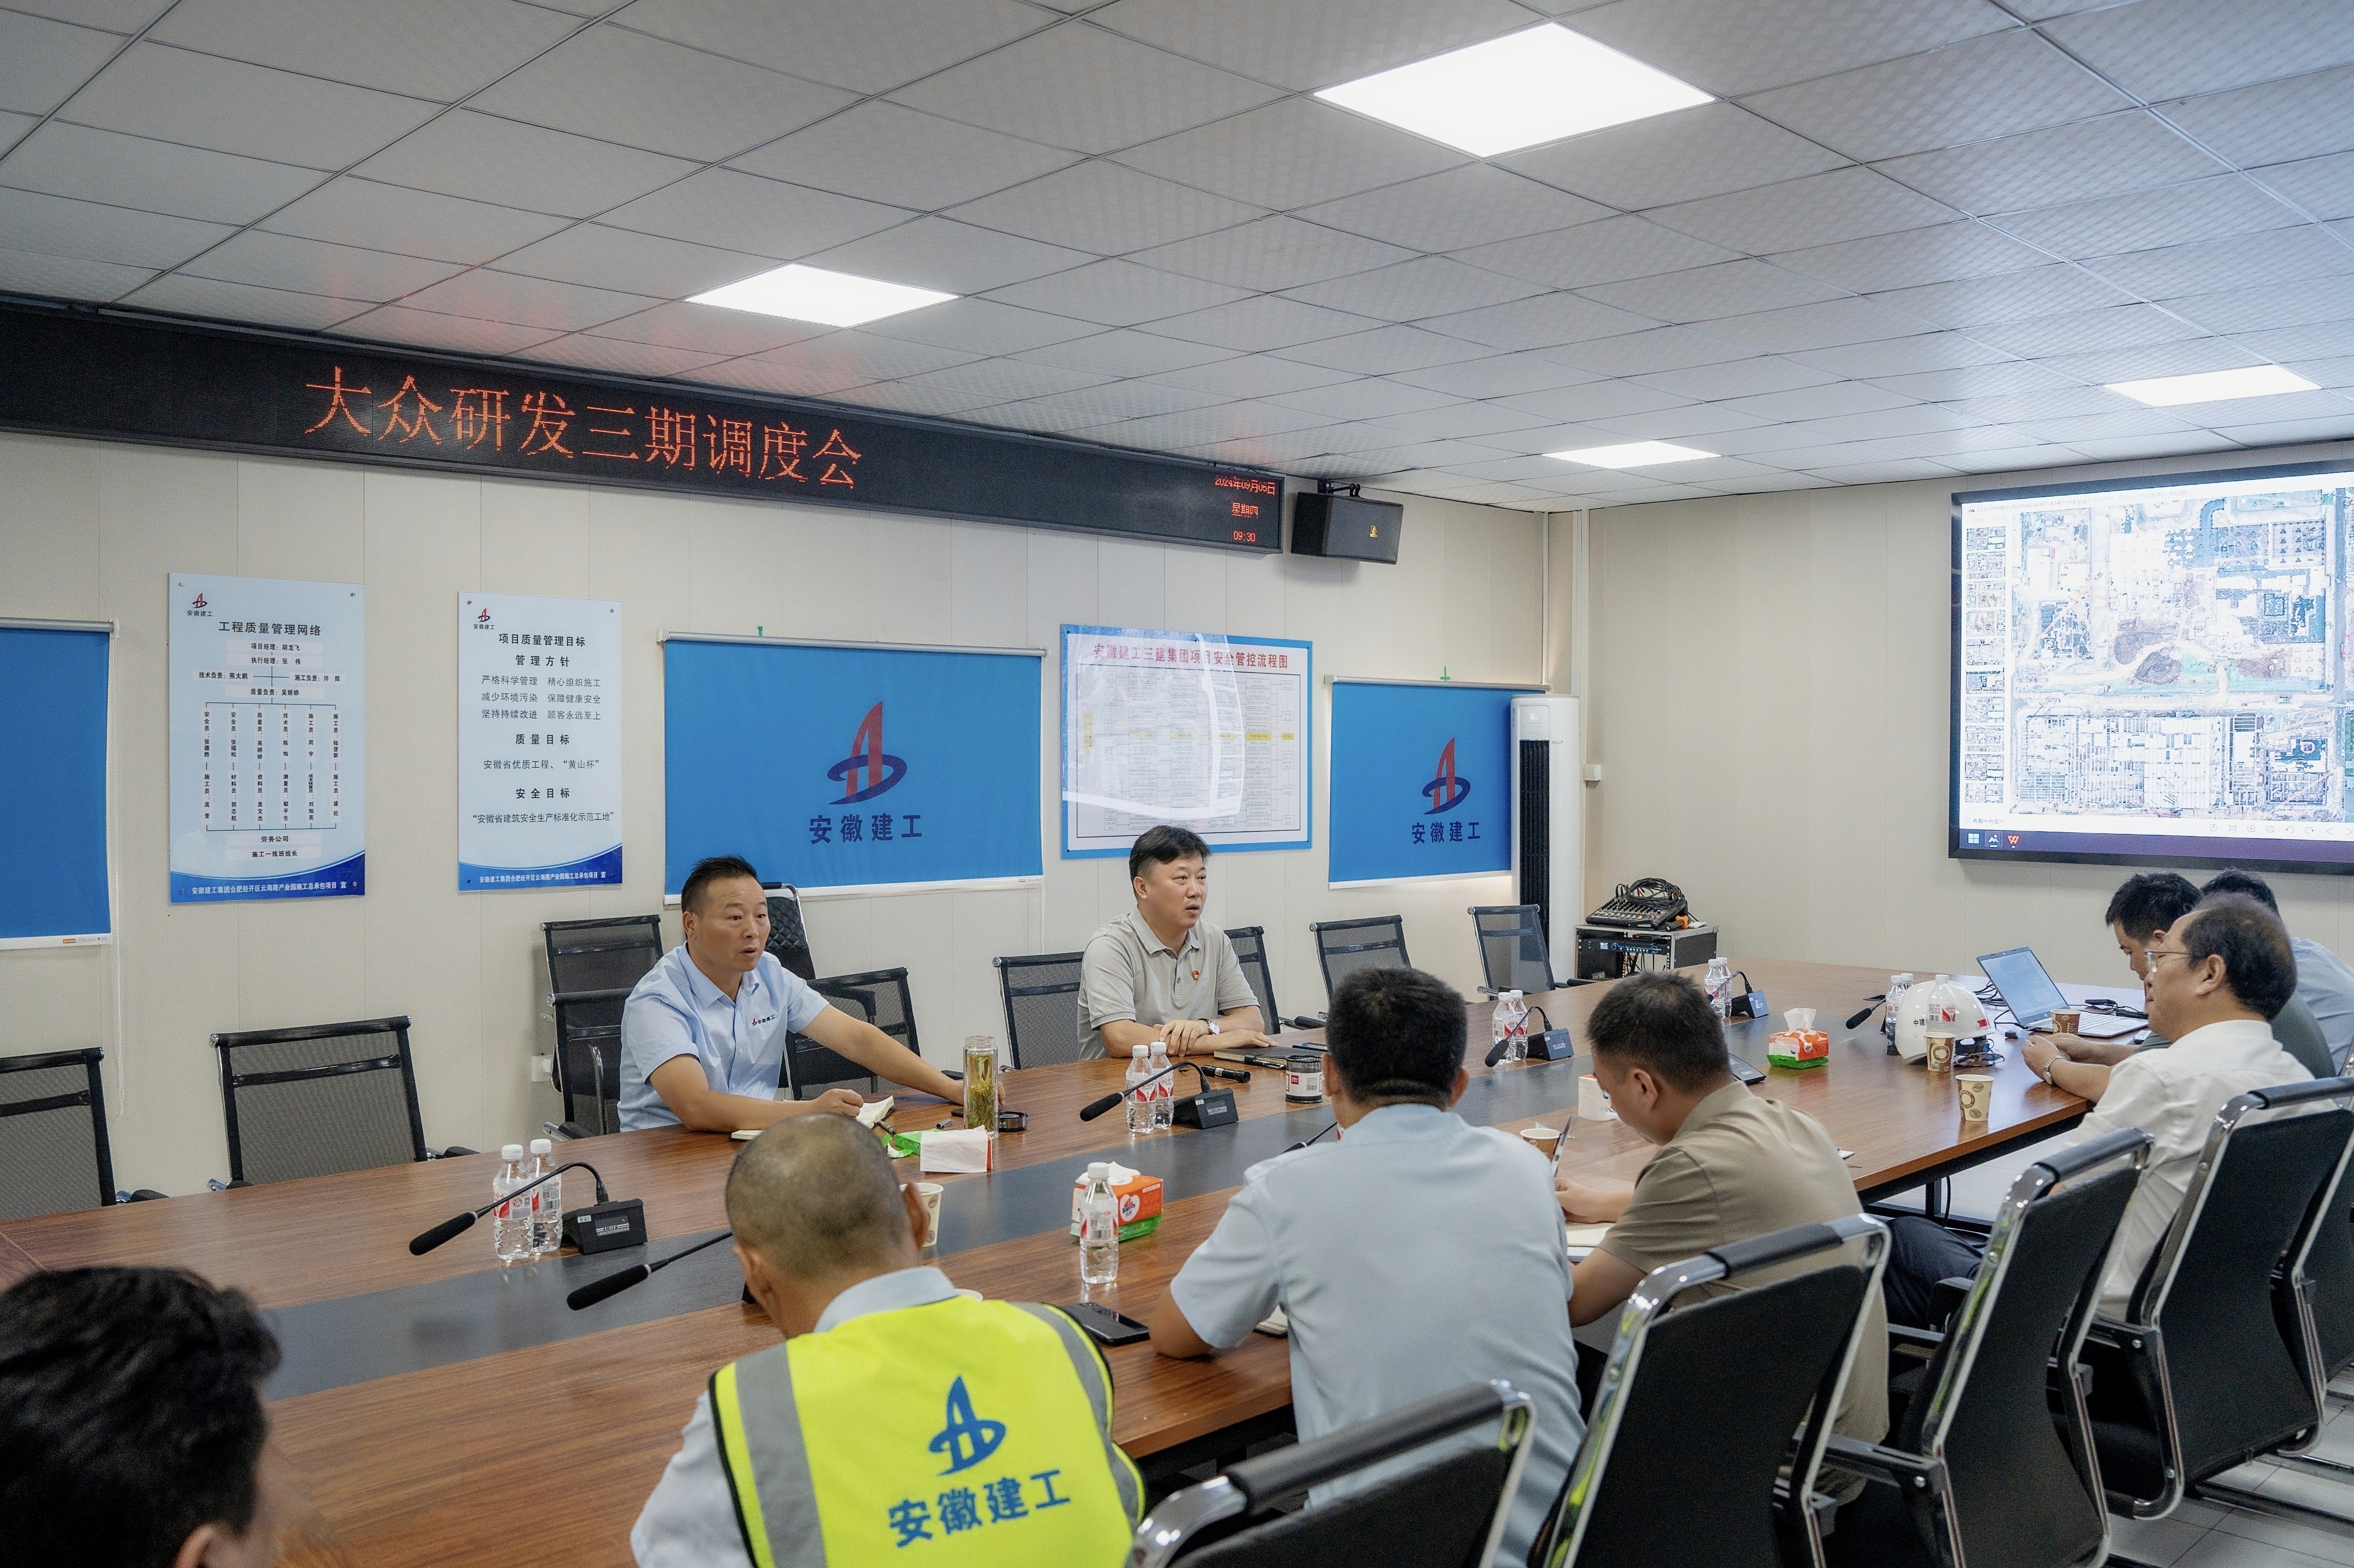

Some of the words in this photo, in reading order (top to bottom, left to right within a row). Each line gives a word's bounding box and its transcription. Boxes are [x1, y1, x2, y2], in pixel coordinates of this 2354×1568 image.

[305, 366, 862, 489] 大众研发三期调度会
[1232, 501, 1259, 518] 星期四
[1233, 530, 1256, 542] 09:30
[219, 621, 321, 636] 工程质量管理网络
[499, 633, 585, 647] 项目质量管理目标
[251, 643, 301, 651] 项目经理：胡龙飞
[515, 655, 570, 667] 管理方针
[1093, 643, 1288, 669] 安徽建工三建集团项目安全管控流程图
[481, 675, 538, 686] 严格科学管理
[548, 677, 601, 687] 精心组织施工
[481, 692, 538, 703] 减少环境污染
[548, 694, 601, 704] 保障健康安全
[481, 709, 538, 719] 坚持持续改进
[548, 710, 601, 720] 顾客永远至上
[515, 734, 570, 745] 质量目标
[515, 788, 570, 799] 安全目标
[809, 813, 923, 844] 安徽建工
[1411, 820, 1481, 844] 安徽建工
[888, 1469, 1071, 1548] 安徽建工
